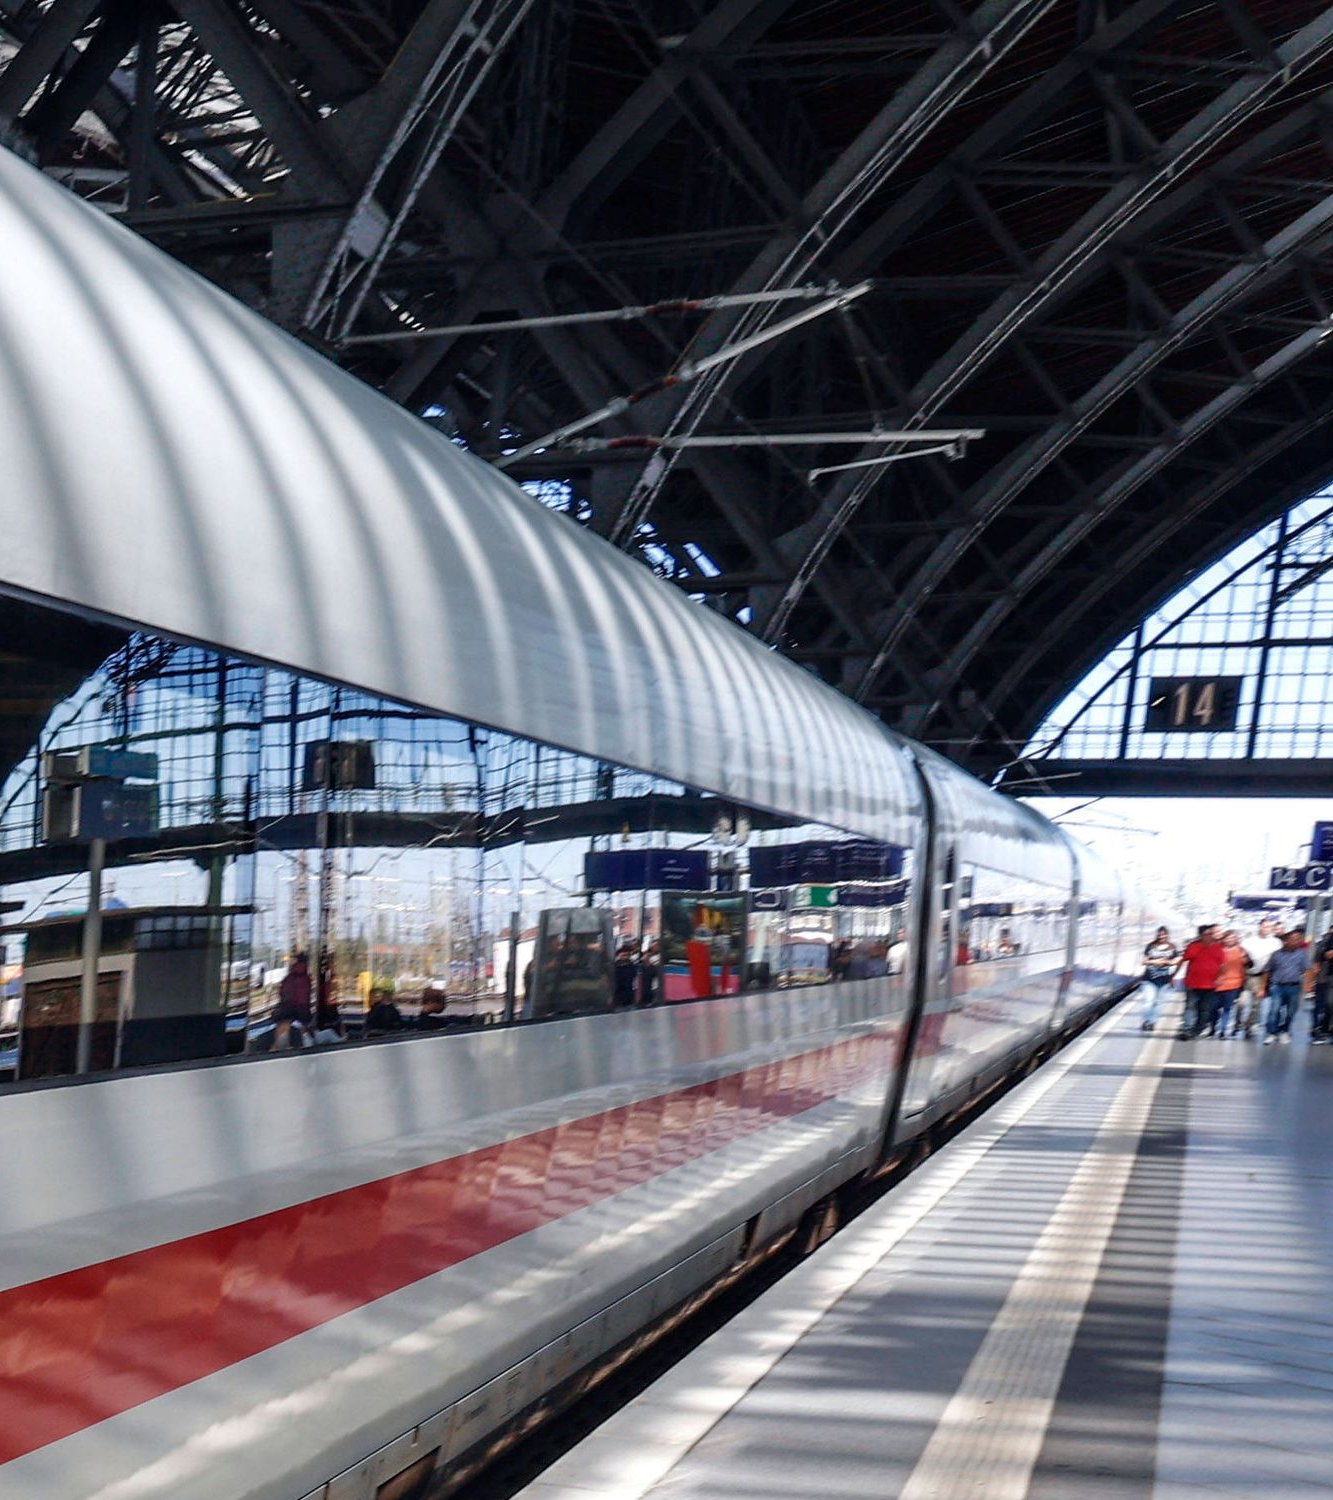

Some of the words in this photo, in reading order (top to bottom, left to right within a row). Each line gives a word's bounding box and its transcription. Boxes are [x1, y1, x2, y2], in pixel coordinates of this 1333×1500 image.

[1173, 682, 1216, 726] 14
[1273, 868, 1297, 886] 14
[1305, 867, 1326, 887] C
